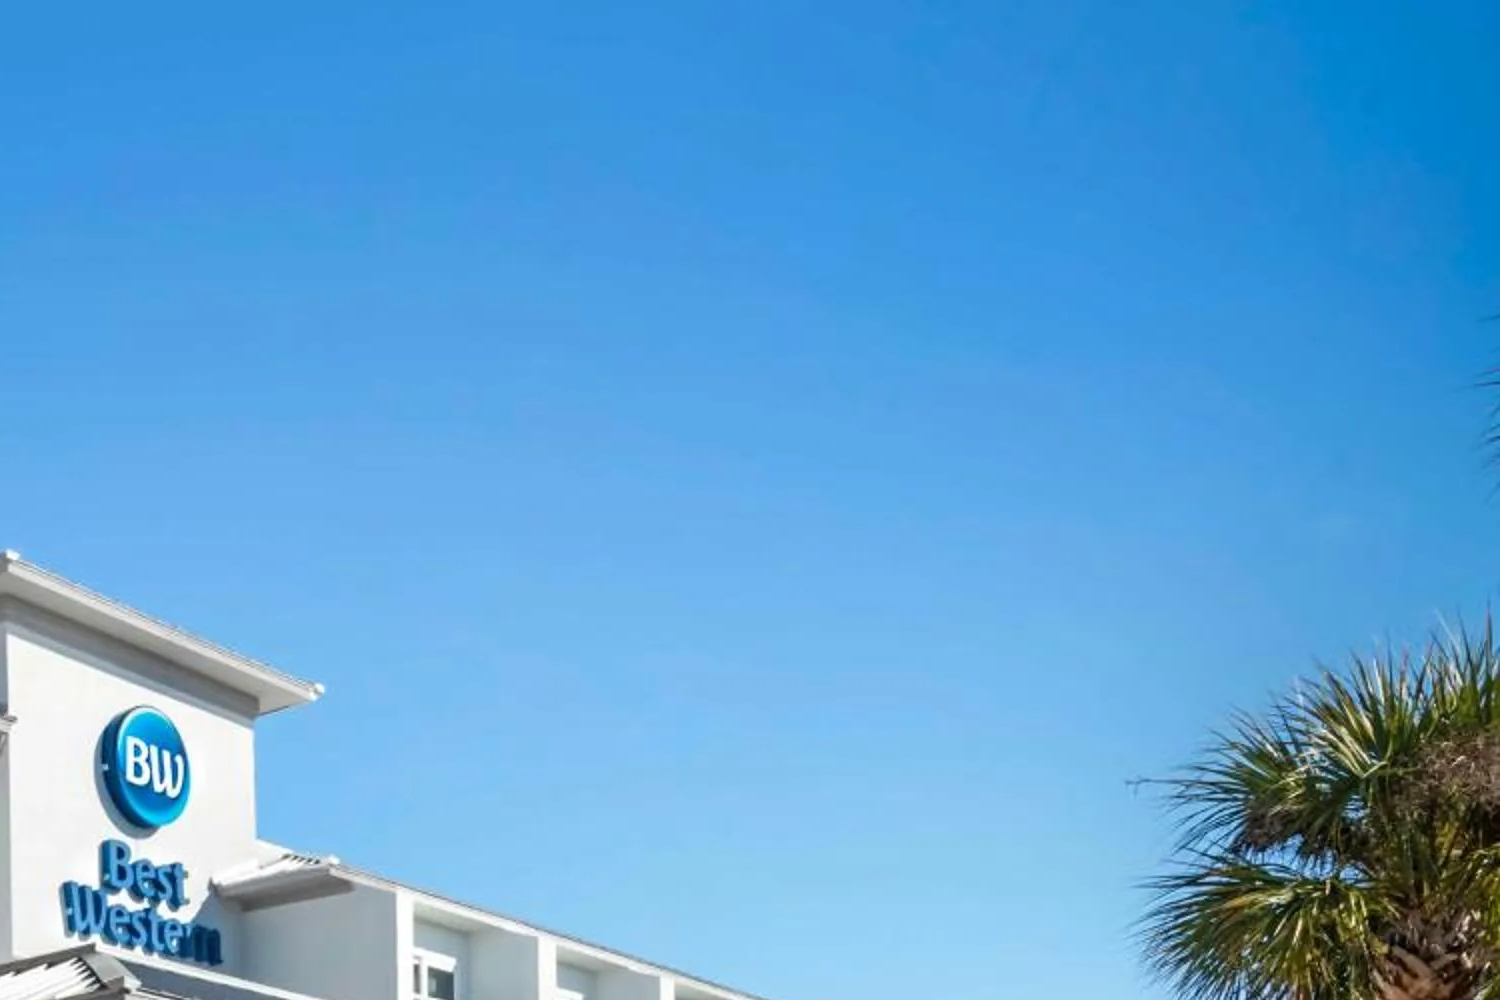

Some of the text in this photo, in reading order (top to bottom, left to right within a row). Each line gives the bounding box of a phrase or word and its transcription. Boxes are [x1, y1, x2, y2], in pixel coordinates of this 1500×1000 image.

[125, 735, 184, 799] BW
[100, 839, 188, 910] Best
[60, 880, 222, 966] Western
